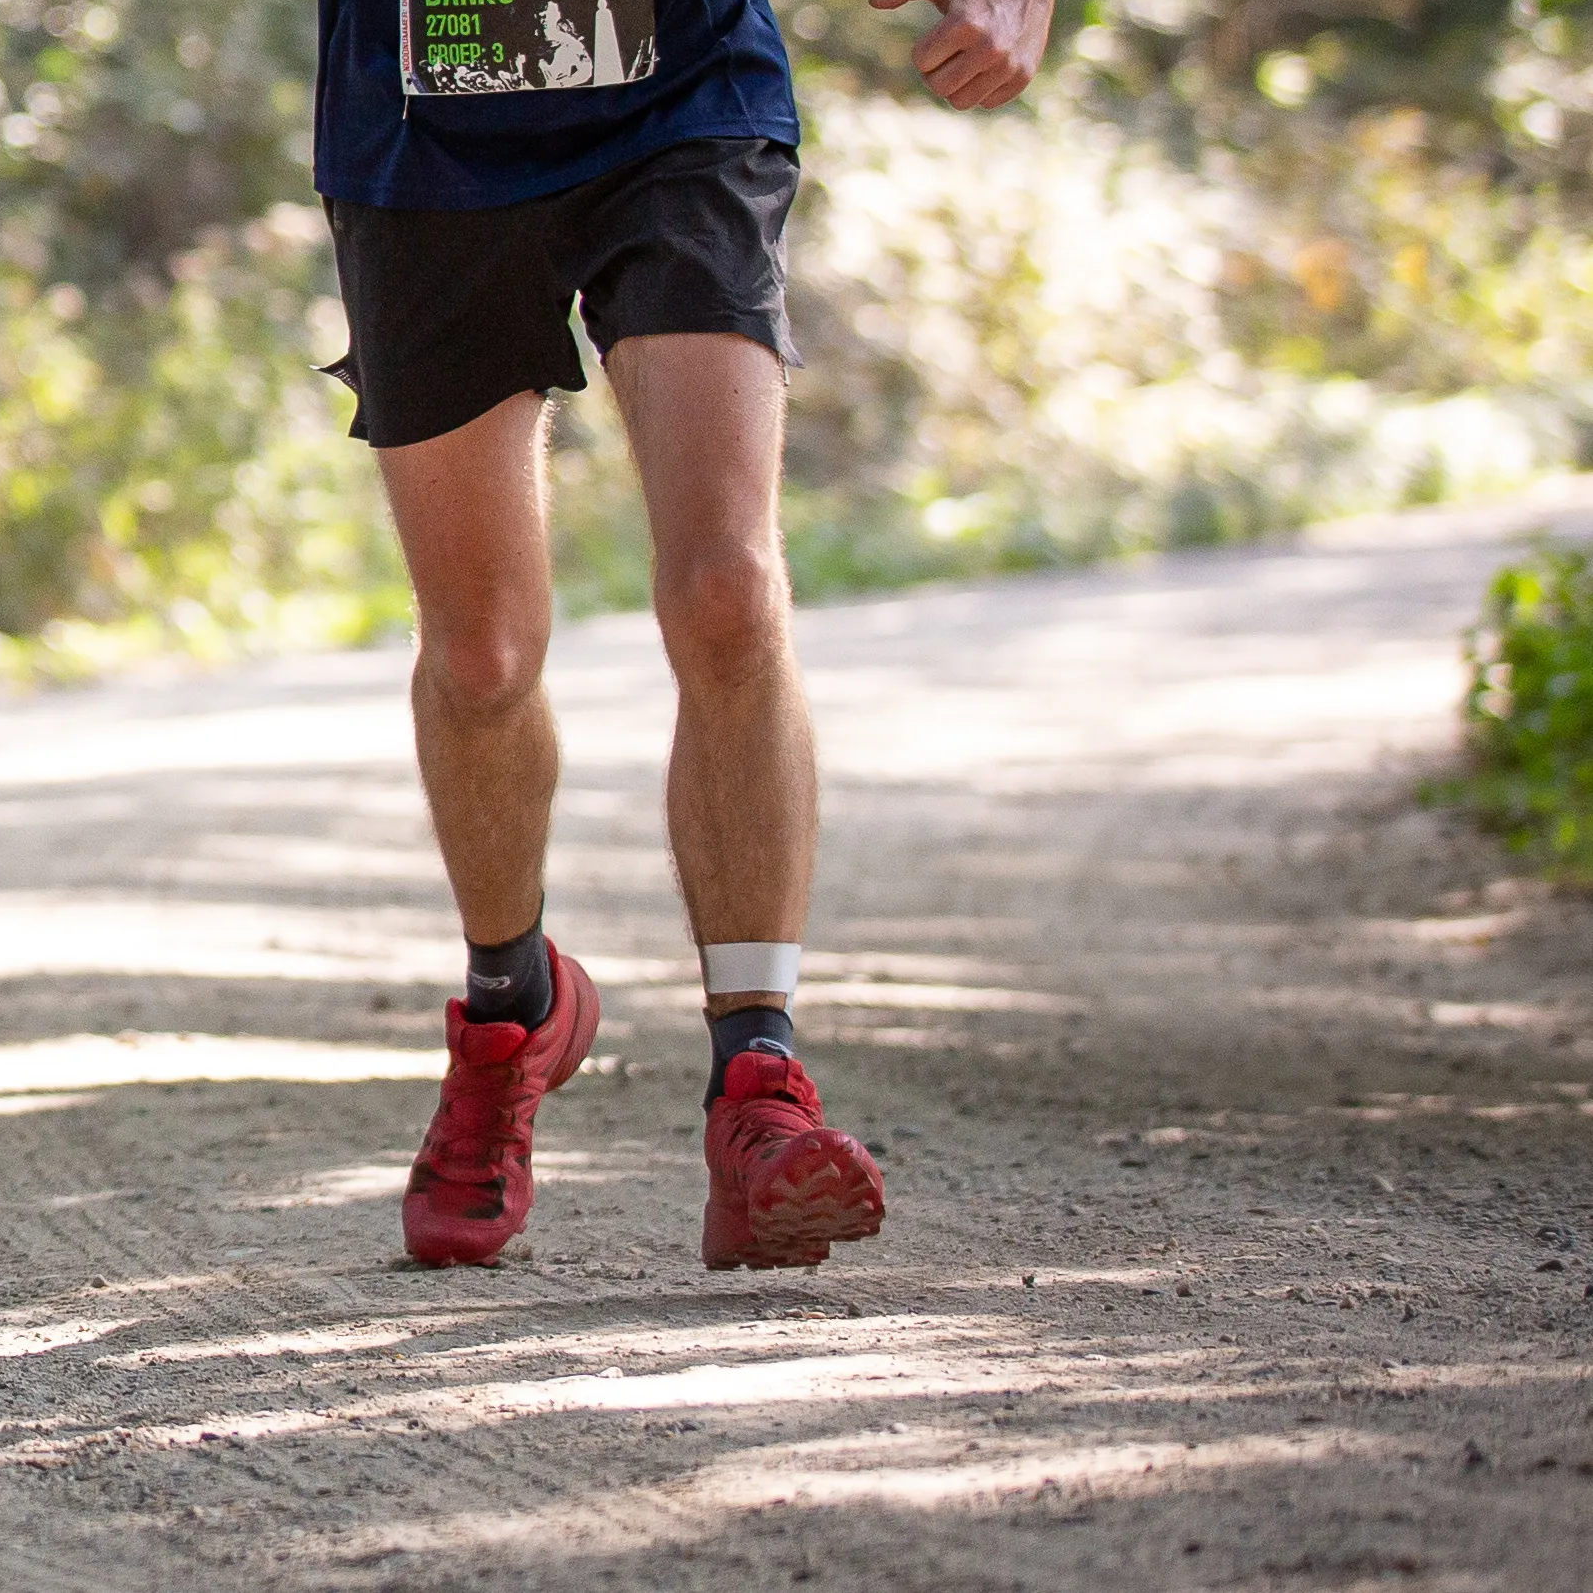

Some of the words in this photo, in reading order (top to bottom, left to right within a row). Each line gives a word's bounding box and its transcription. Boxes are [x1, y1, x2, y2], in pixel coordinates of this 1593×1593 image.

[426, 13, 481, 37] 27081
[427, 43, 488, 66] GROEP:
[493, 43, 504, 64] 3
